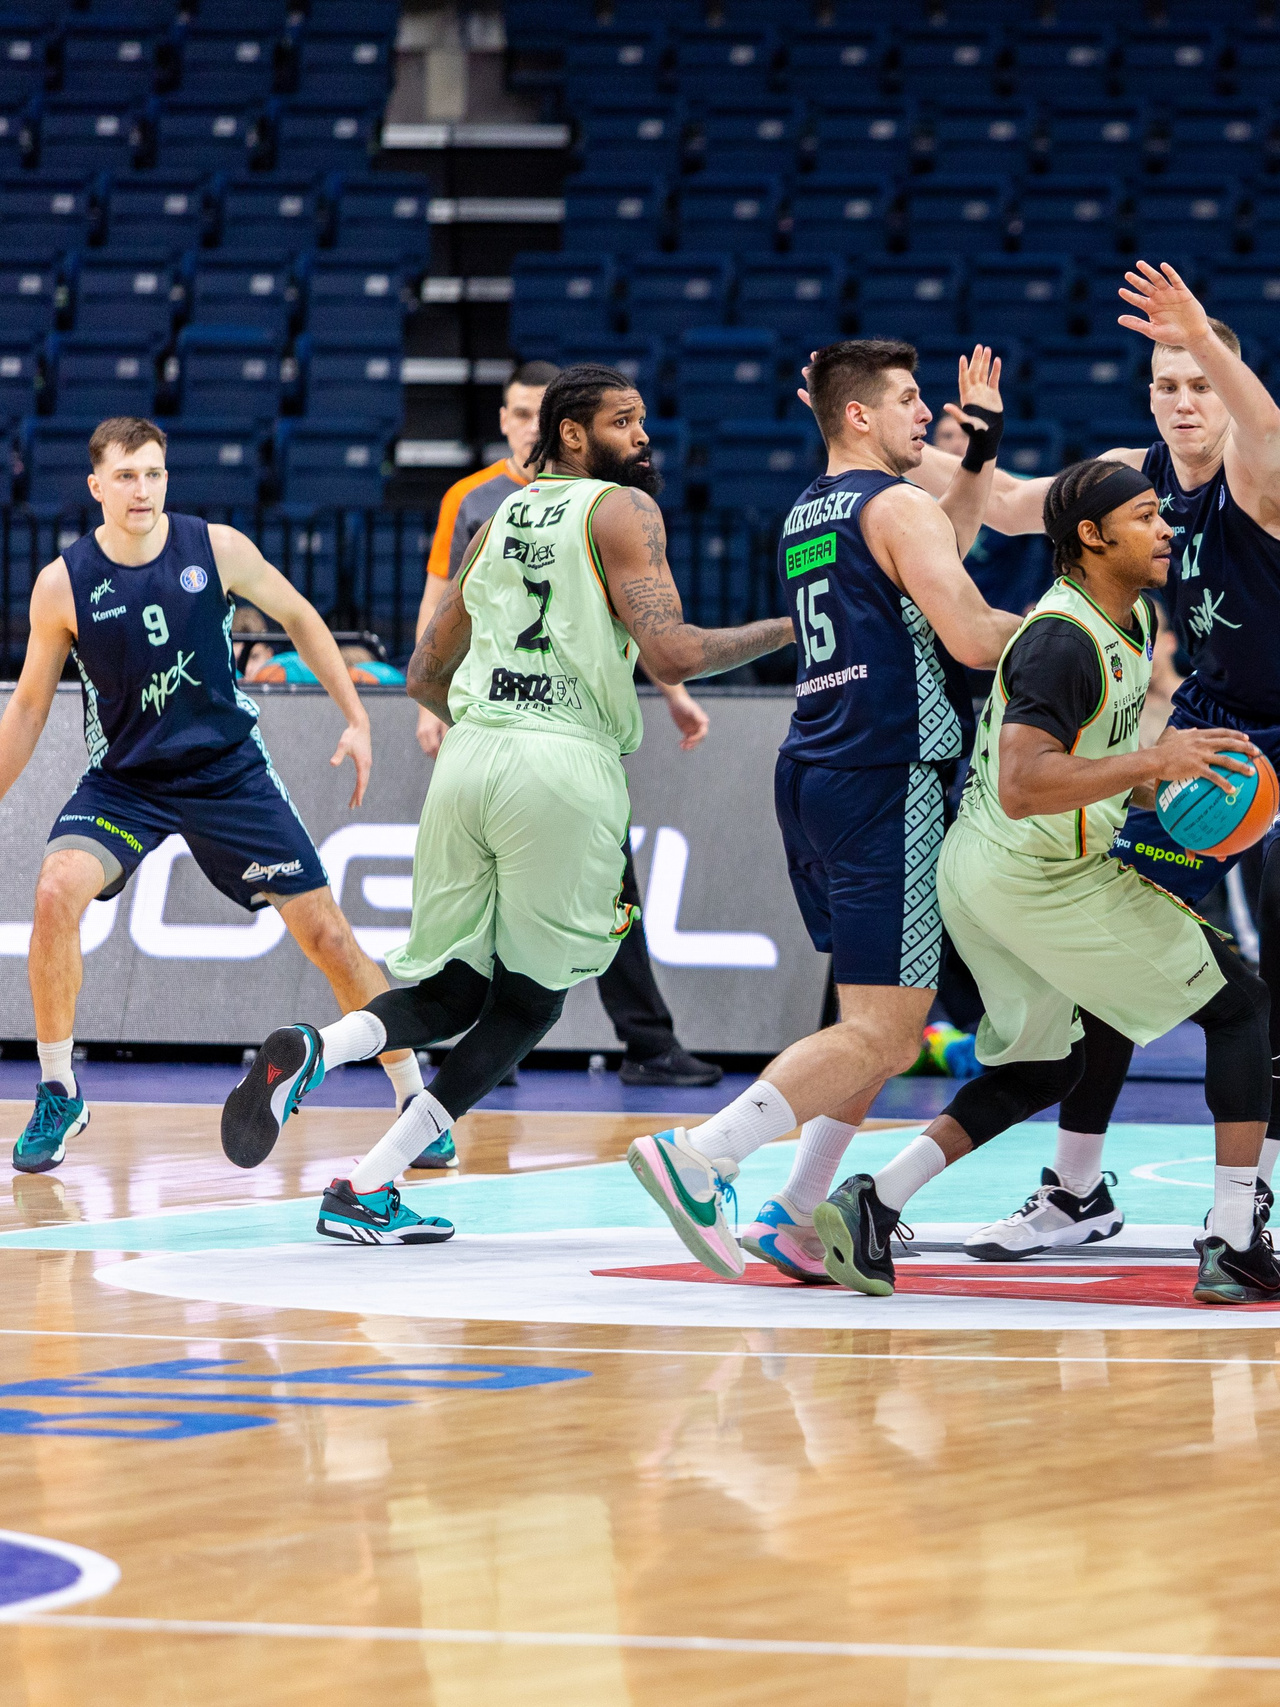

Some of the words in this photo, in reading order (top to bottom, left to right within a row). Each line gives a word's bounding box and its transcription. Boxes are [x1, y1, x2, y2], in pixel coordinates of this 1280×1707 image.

[92, 605, 127, 623] Kempa
[142, 604, 170, 647] 9
[514, 576, 553, 654] 2
[796, 578, 837, 669] 15
